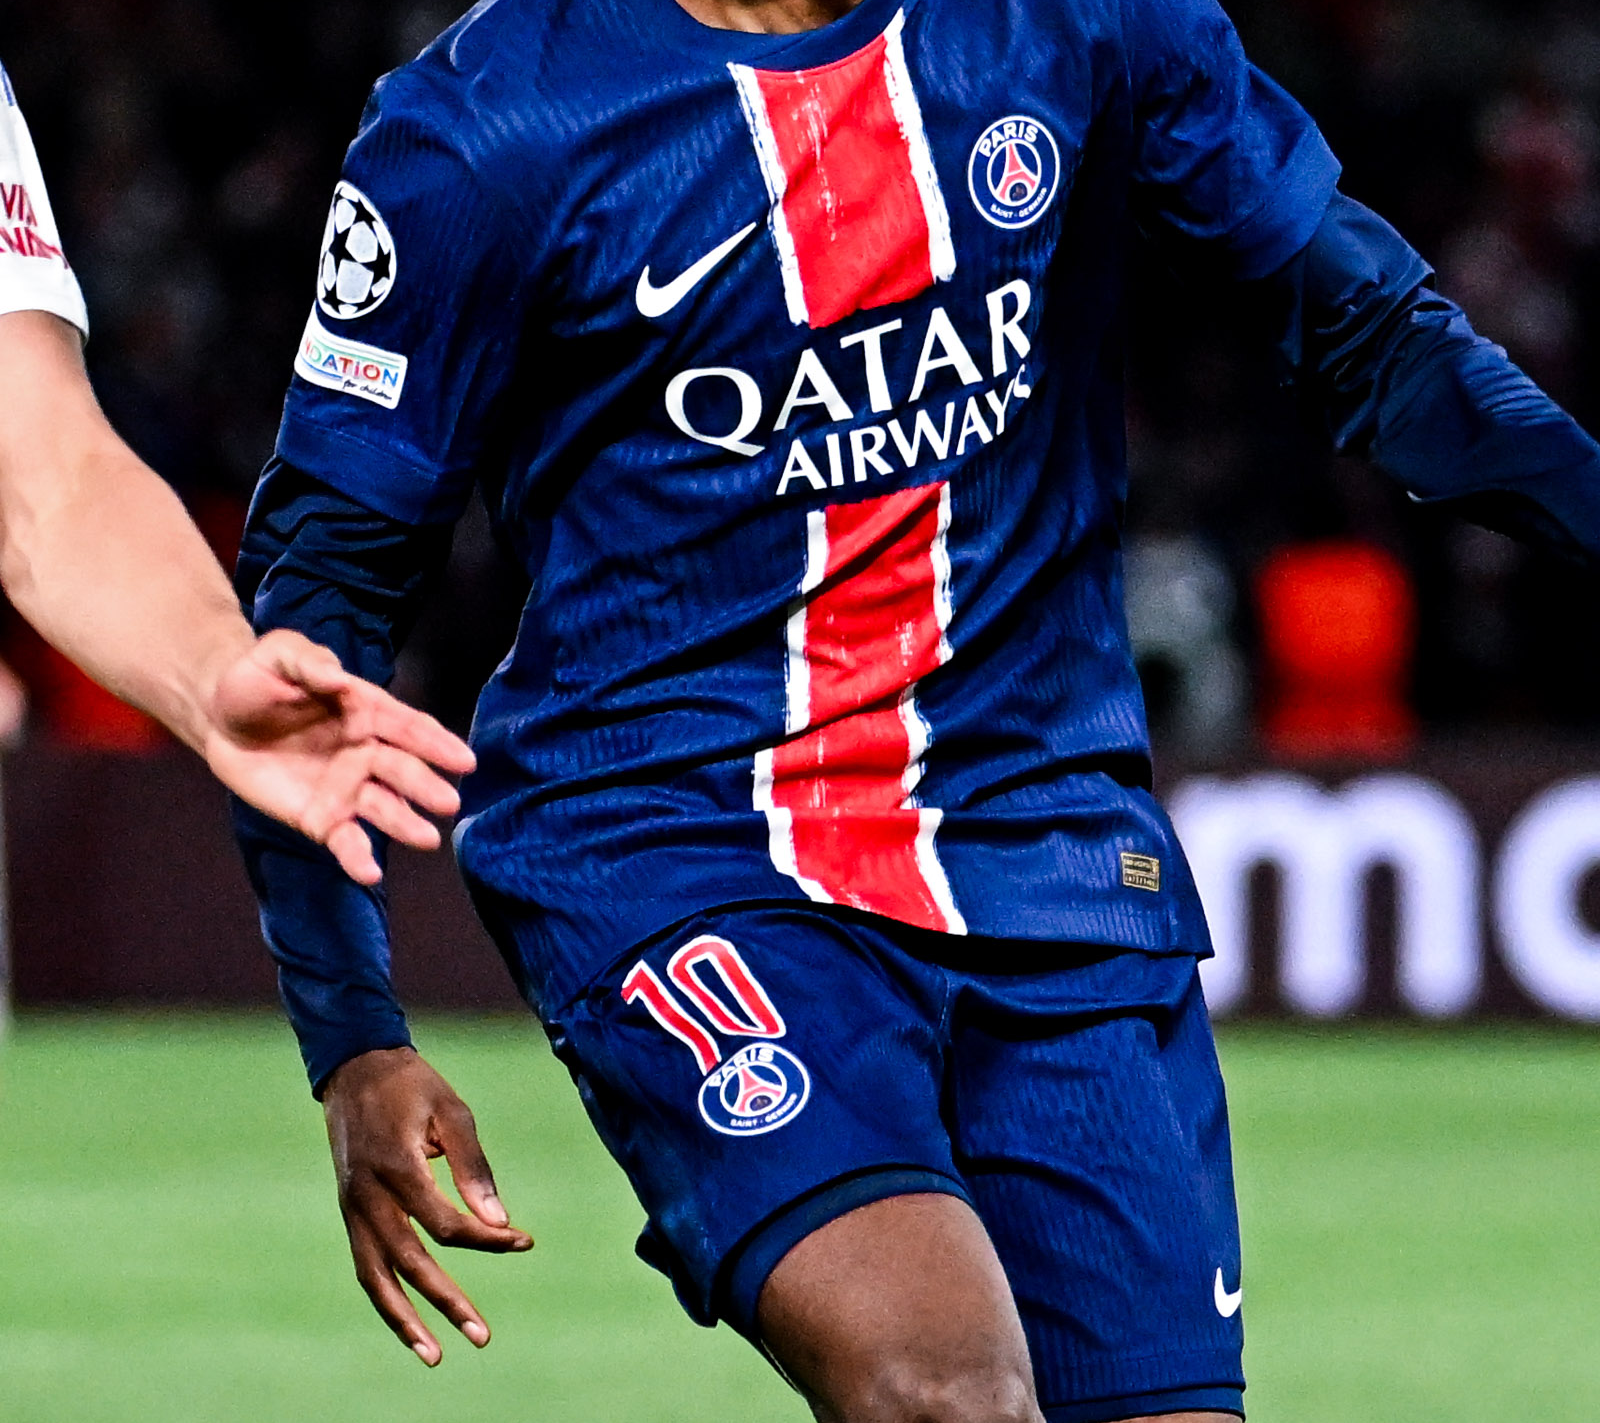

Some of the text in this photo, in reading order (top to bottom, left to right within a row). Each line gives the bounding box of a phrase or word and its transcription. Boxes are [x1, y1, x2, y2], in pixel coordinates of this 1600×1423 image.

[978, 122, 1038, 157] PARIS
[665, 279, 1031, 457] QATAR
[621, 935, 786, 1076] 10
[708, 1048, 775, 1087] PARIS
